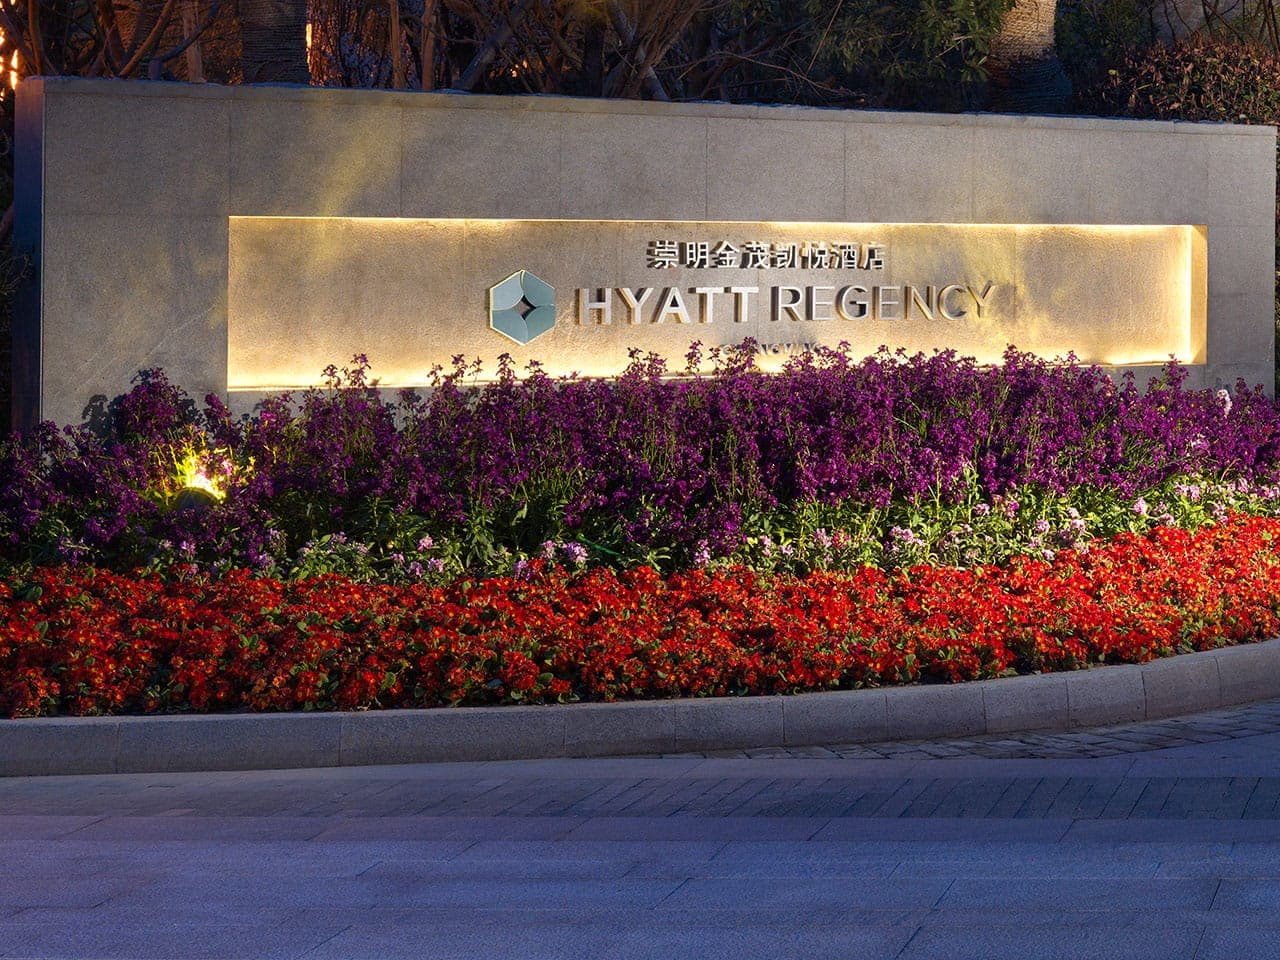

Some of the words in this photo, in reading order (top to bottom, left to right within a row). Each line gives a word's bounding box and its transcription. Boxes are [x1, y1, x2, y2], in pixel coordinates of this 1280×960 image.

[649, 240, 887, 270] 崇明金茂凯悦酒店
[577, 286, 760, 324] HYATT
[772, 282, 999, 321] REGENCY
